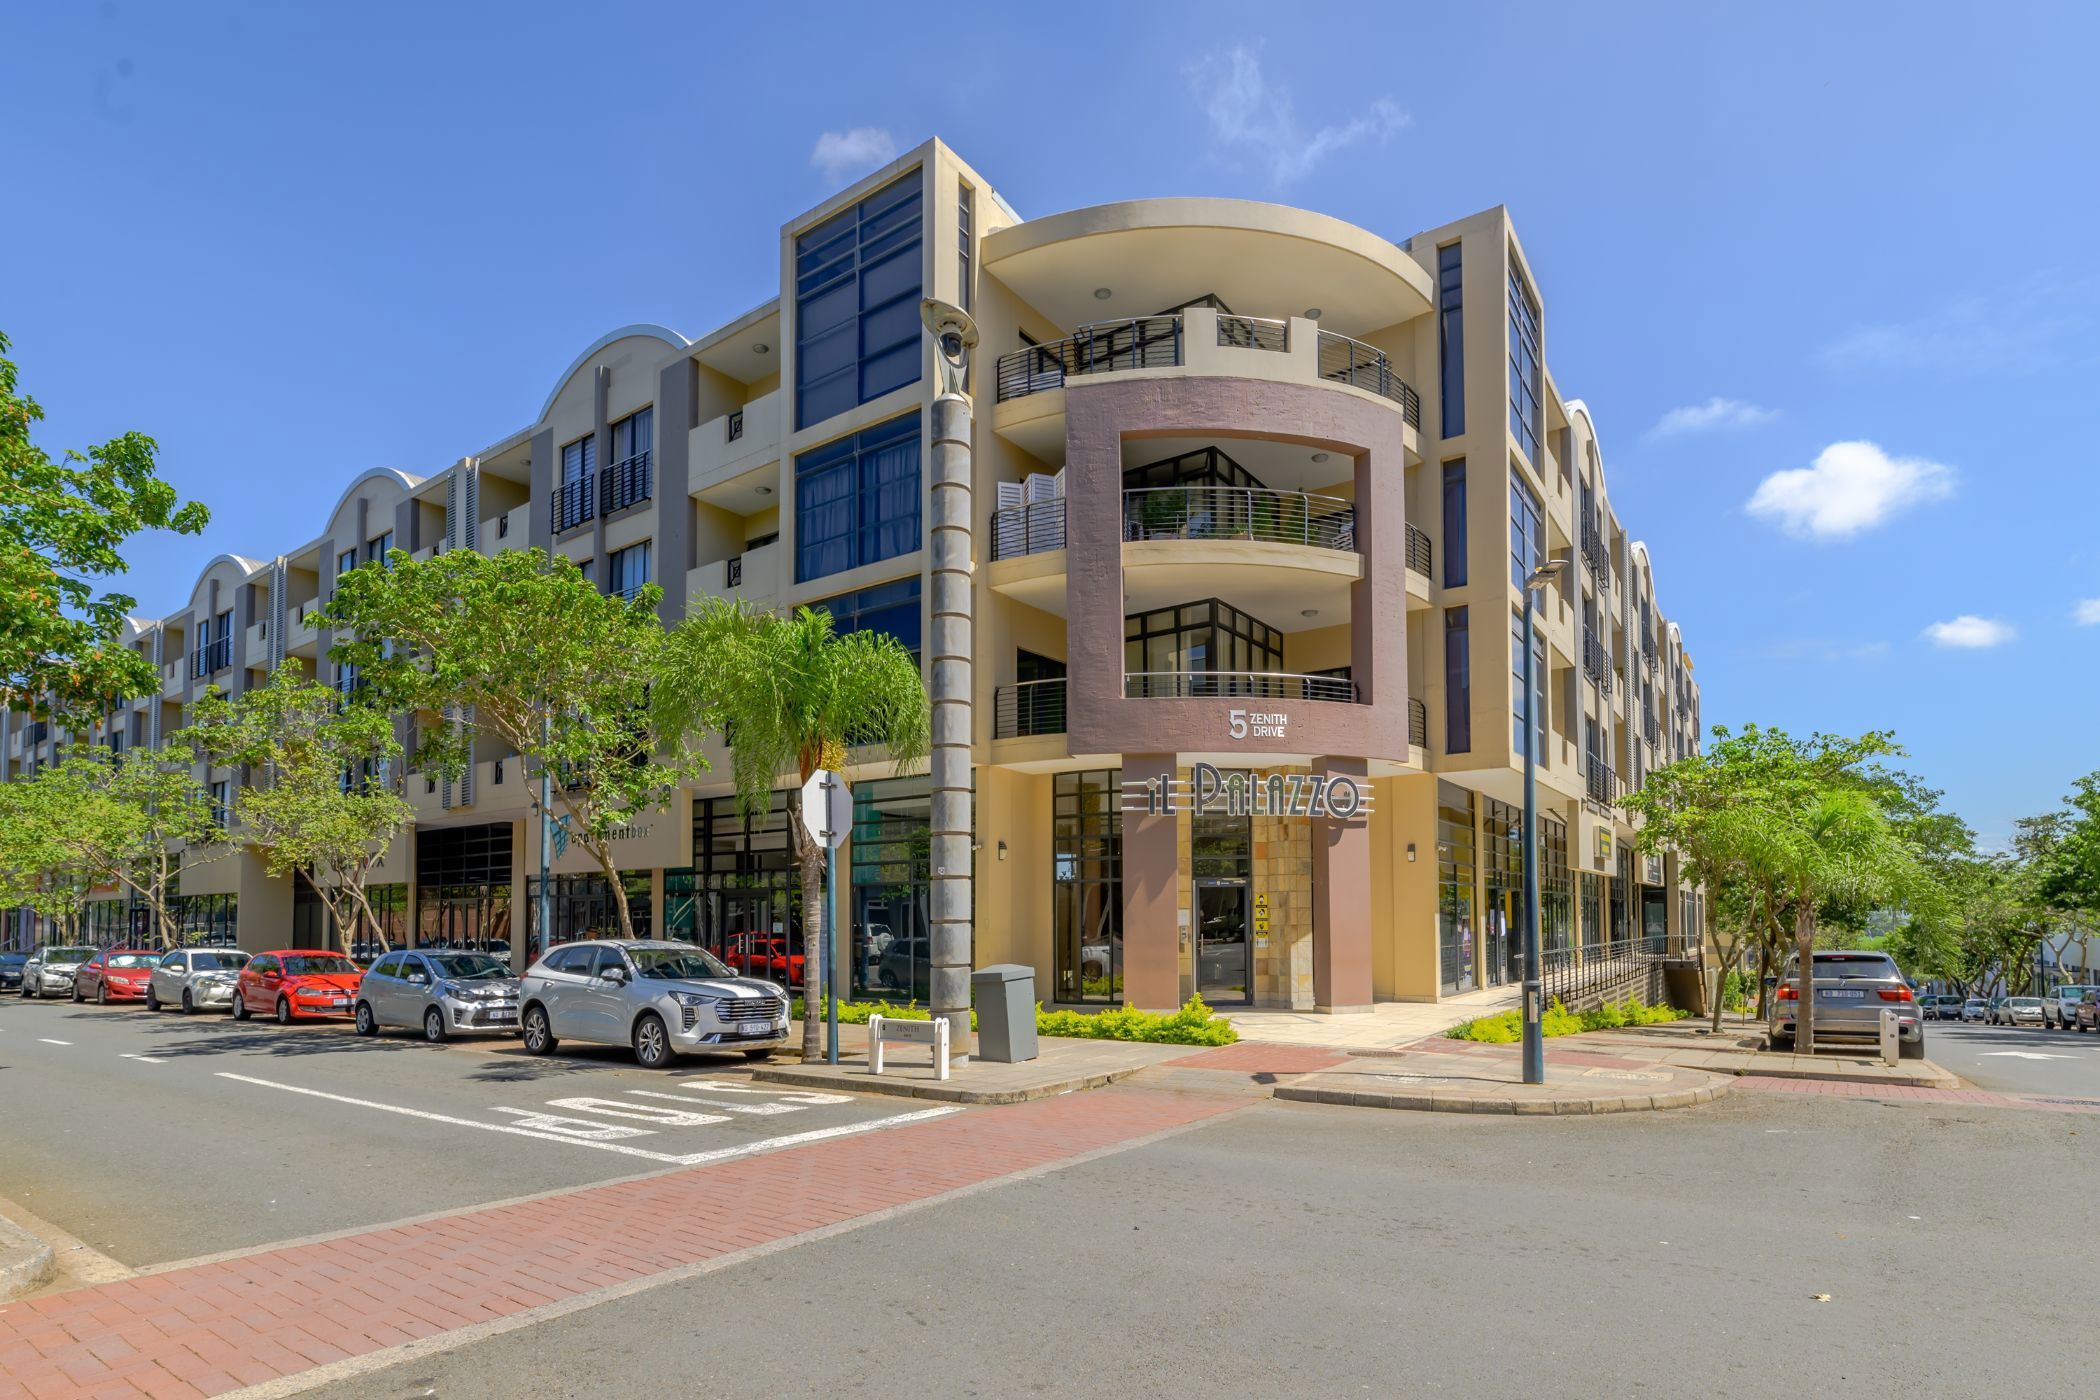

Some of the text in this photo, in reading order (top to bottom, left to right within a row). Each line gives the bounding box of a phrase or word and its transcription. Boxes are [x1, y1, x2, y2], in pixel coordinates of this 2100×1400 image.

[1228, 709, 1288, 740] 5 ZENITH
[1253, 726, 1285, 738] DRIVE
[1194, 762, 1361, 819] PALAZZO
[896, 1024, 921, 1033] ZENITH
[488, 1080, 856, 1141] STOP
